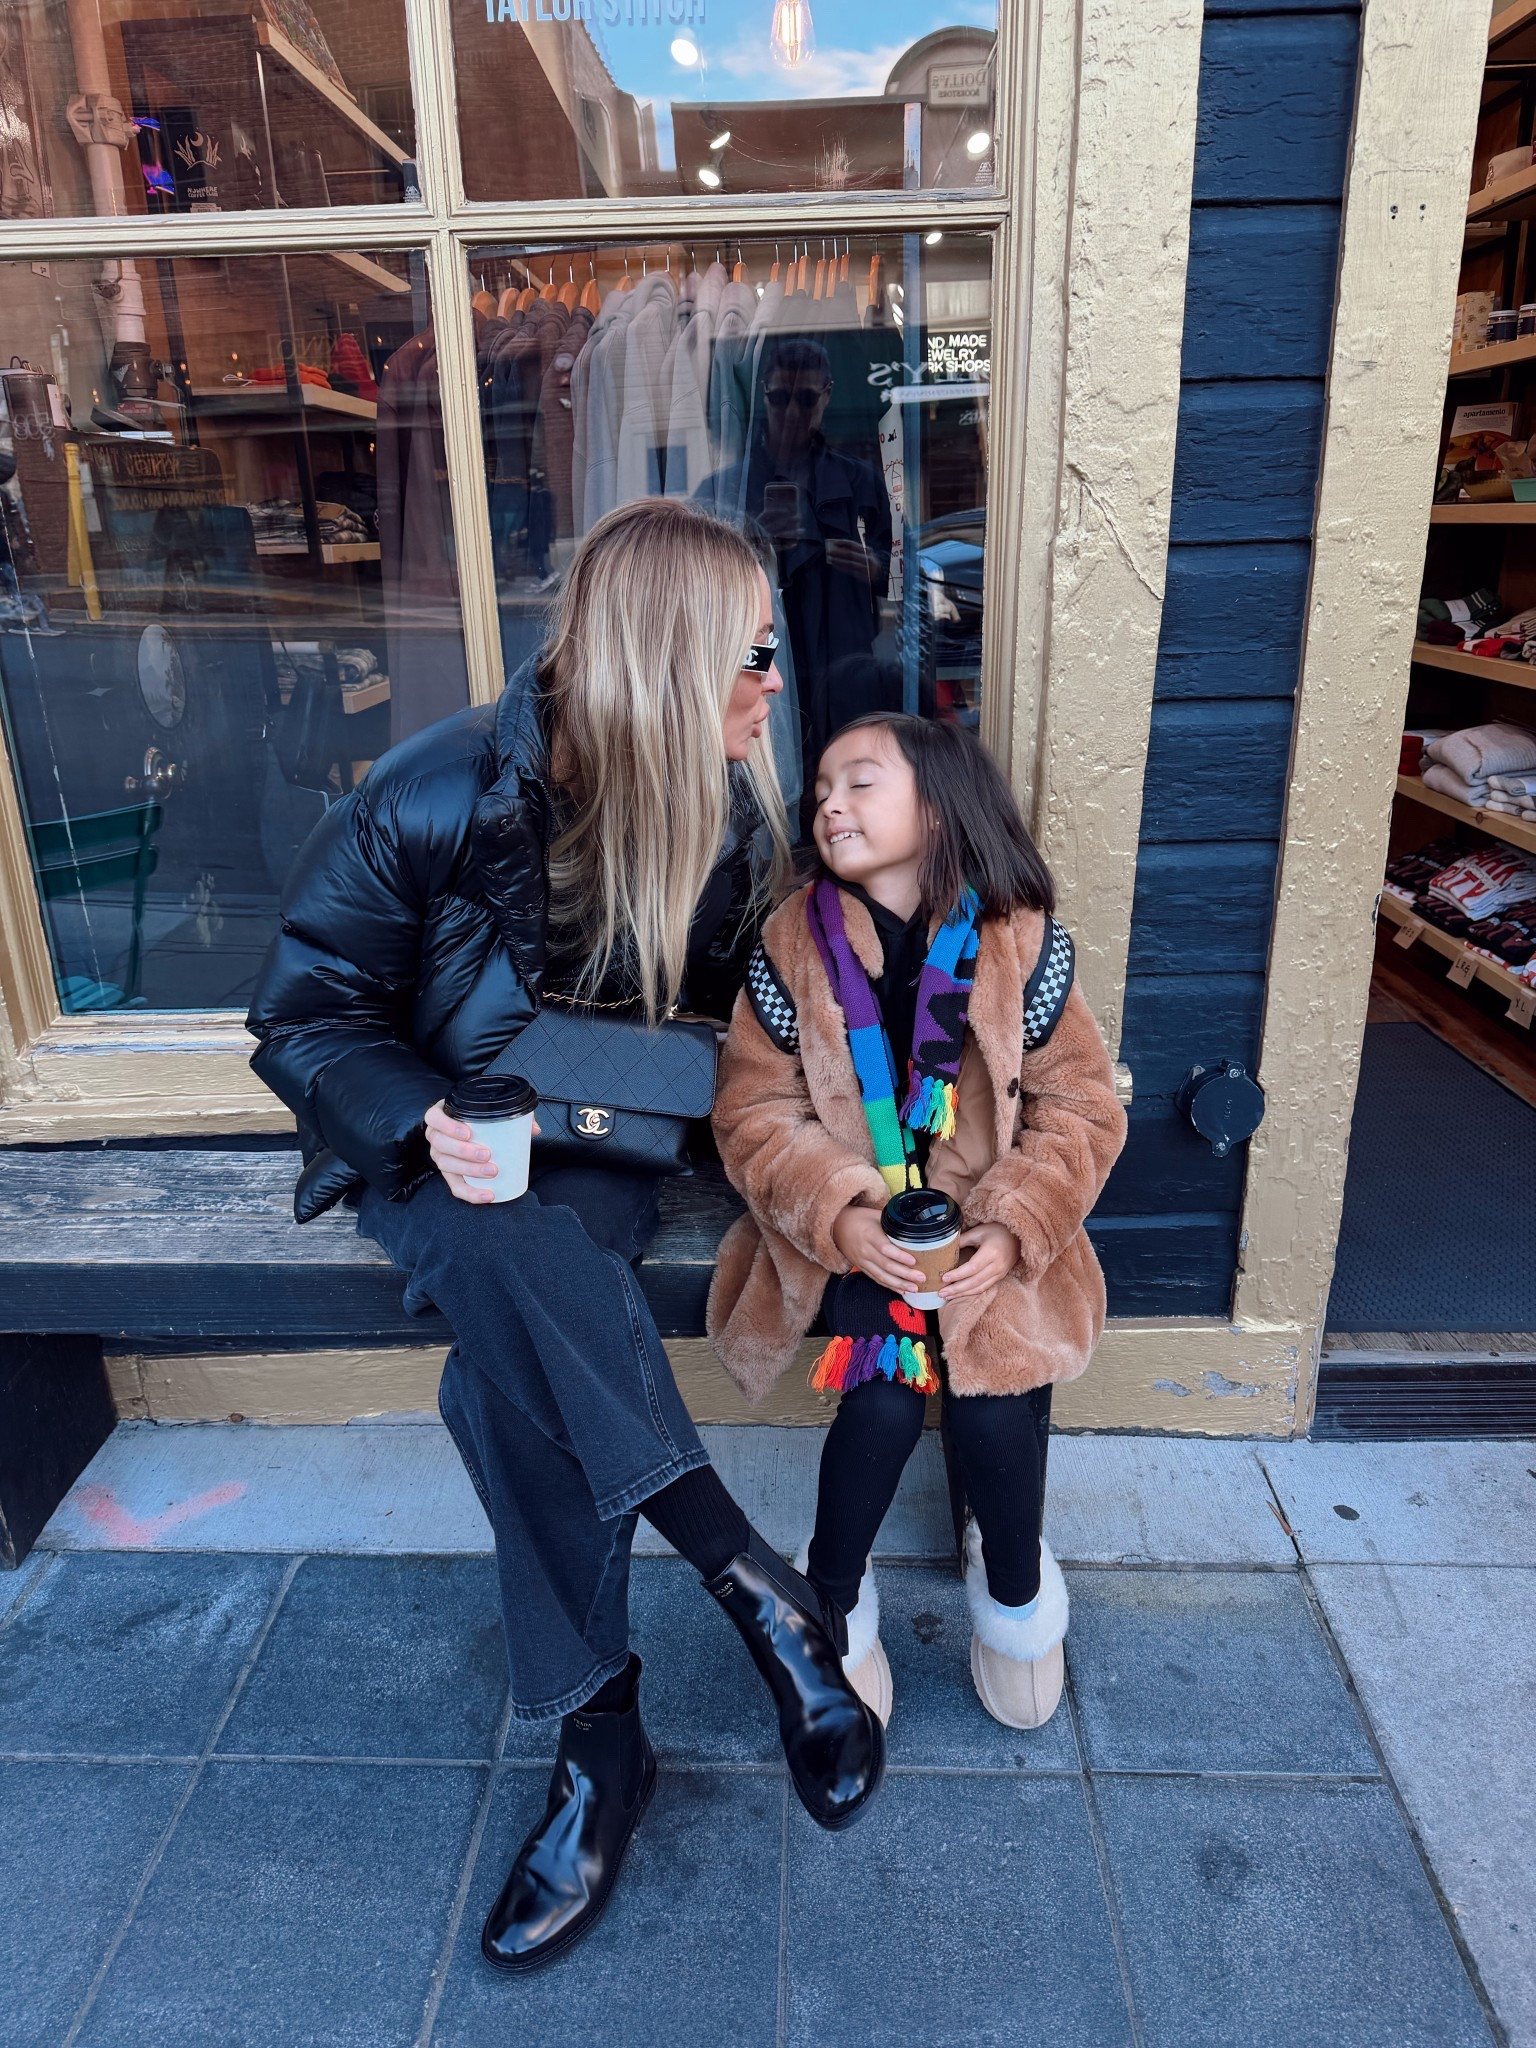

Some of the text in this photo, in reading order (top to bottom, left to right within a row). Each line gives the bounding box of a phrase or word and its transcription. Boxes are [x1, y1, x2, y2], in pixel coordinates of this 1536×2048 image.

[949, 334, 987, 347] MADE
[946, 359, 991, 373] SHOPS
[1463, 408, 1506, 418] apartamento
